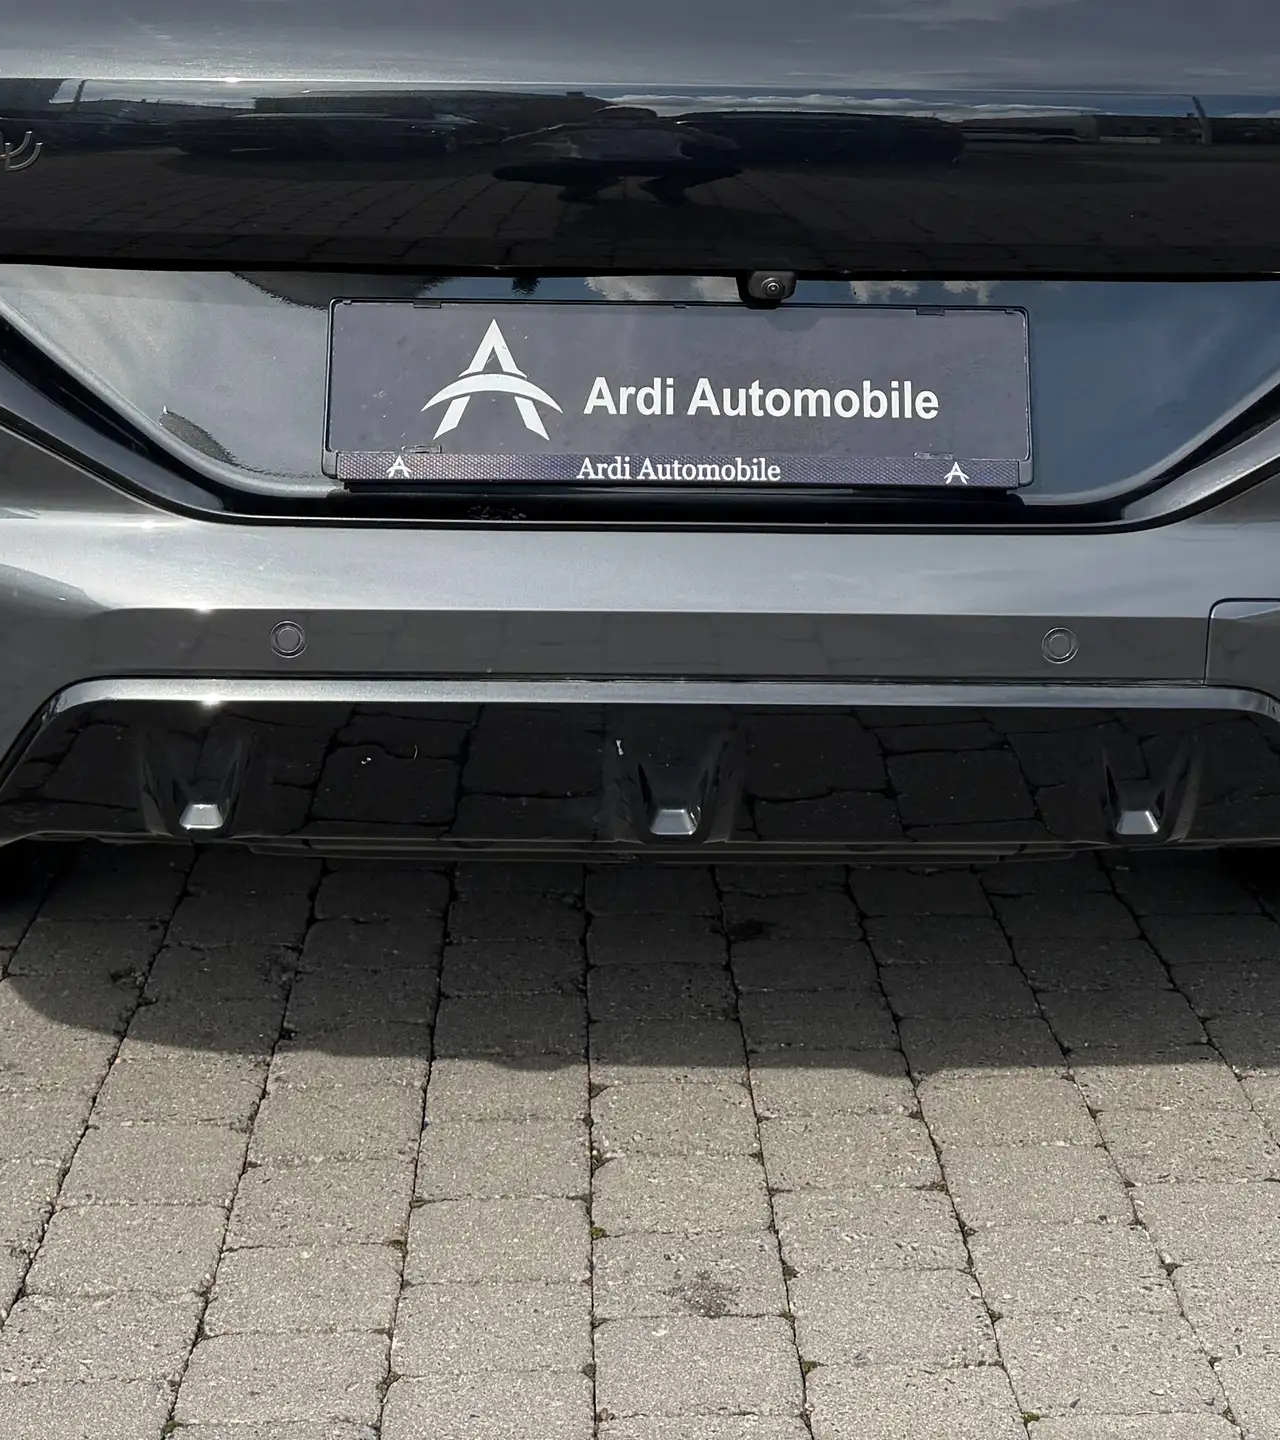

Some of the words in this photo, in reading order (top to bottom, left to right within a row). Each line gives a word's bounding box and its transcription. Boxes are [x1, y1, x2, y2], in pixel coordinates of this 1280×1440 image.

[583, 376, 675, 416] Ardi
[687, 377, 939, 420] Automobile
[576, 456, 631, 480] Ardi
[634, 457, 781, 481] Automobile
